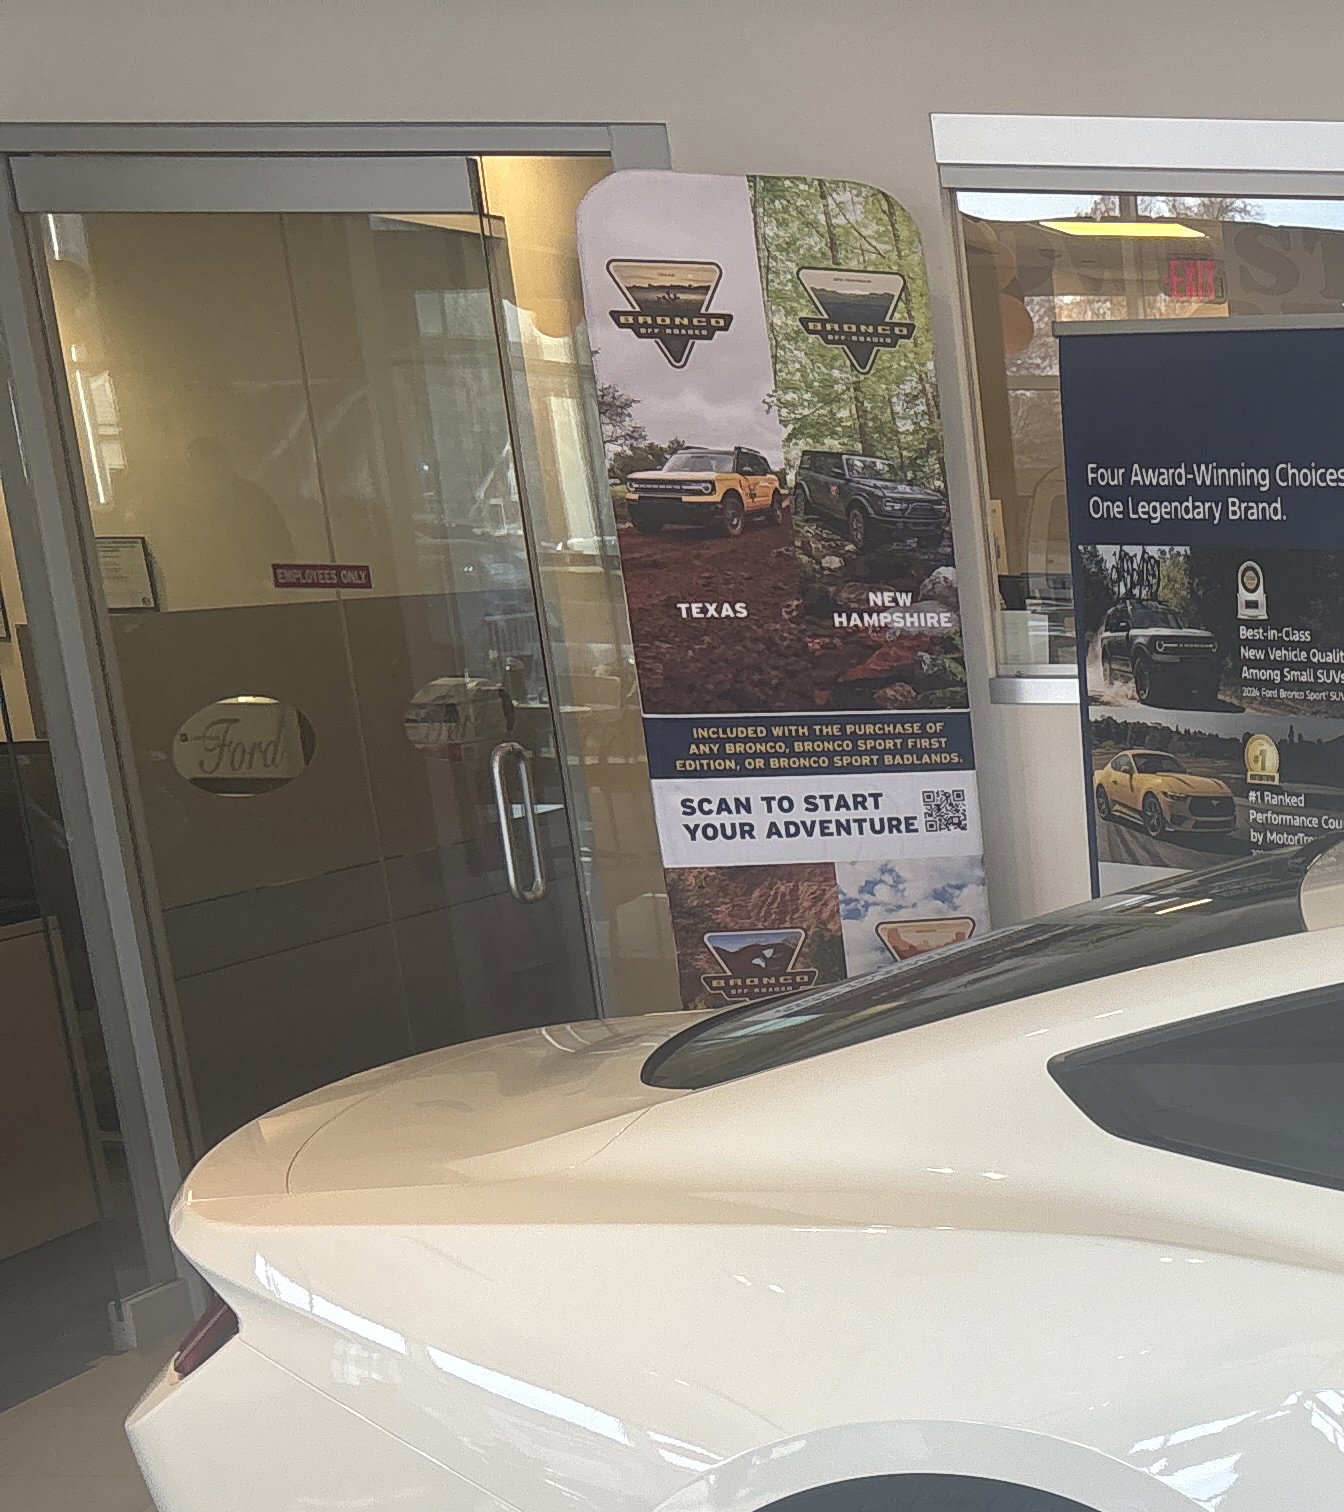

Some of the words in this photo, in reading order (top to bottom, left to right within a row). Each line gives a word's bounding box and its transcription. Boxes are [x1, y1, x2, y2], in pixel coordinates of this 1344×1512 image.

[618, 314, 727, 328] BRONCO
[807, 321, 909, 336] BRONCO
[1087, 463, 1126, 488] Four
[1130, 462, 1271, 492] Award-Winning
[1089, 496, 1125, 520] One
[1128, 495, 1223, 525] Legendary
[1227, 496, 1288, 522] Brand.
[275, 569, 338, 584] EMPLOYEES
[340, 569, 367, 585] ONLY
[867, 591, 913, 608] NEW
[676, 602, 749, 619] TEXAS
[833, 611, 953, 629] HAMPSHIRE
[1239, 625, 1312, 642] Best-in-Class
[1240, 645, 1266, 661] New
[1267, 646, 1308, 662] Vehicle
[1241, 665, 1281, 684] Among
[1283, 667, 1315, 683] Small
[1261, 687, 1278, 699] Ford
[1279, 688, 1305, 700] Bronco
[692, 724, 767, 739] INCLUDED
[771, 723, 808, 738] WITH
[812, 722, 842, 737] THE
[846, 722, 922, 736] PURCHASE
[926, 721, 945, 735] OF
[199, 711, 286, 774] Ford
[688, 741, 720, 755] ANY
[725, 740, 790, 756] BRONCO,
[794, 739, 853, 753] BRONCO
[857, 738, 903, 752] SPORT
[907, 737, 948, 750] FIRST
[675, 758, 742, 773] EDITION,
[745, 757, 765, 771] OR
[769, 755, 829, 770] BRONCO
[833, 754, 880, 768] SPORT
[884, 751, 964, 767] BADLANDS.
[680, 796, 752, 817] SCAN
[760, 794, 795, 815] TO
[803, 792, 884, 813] START
[1248, 789, 1261, 804] #1
[1263, 791, 1306, 808] Ranked
[1249, 809, 1319, 828] Performance
[683, 821, 756, 843] YOUR
[765, 816, 920, 841] ADVENTURE
[1250, 828, 1264, 845] by
[711, 974, 810, 988] BRONCO
